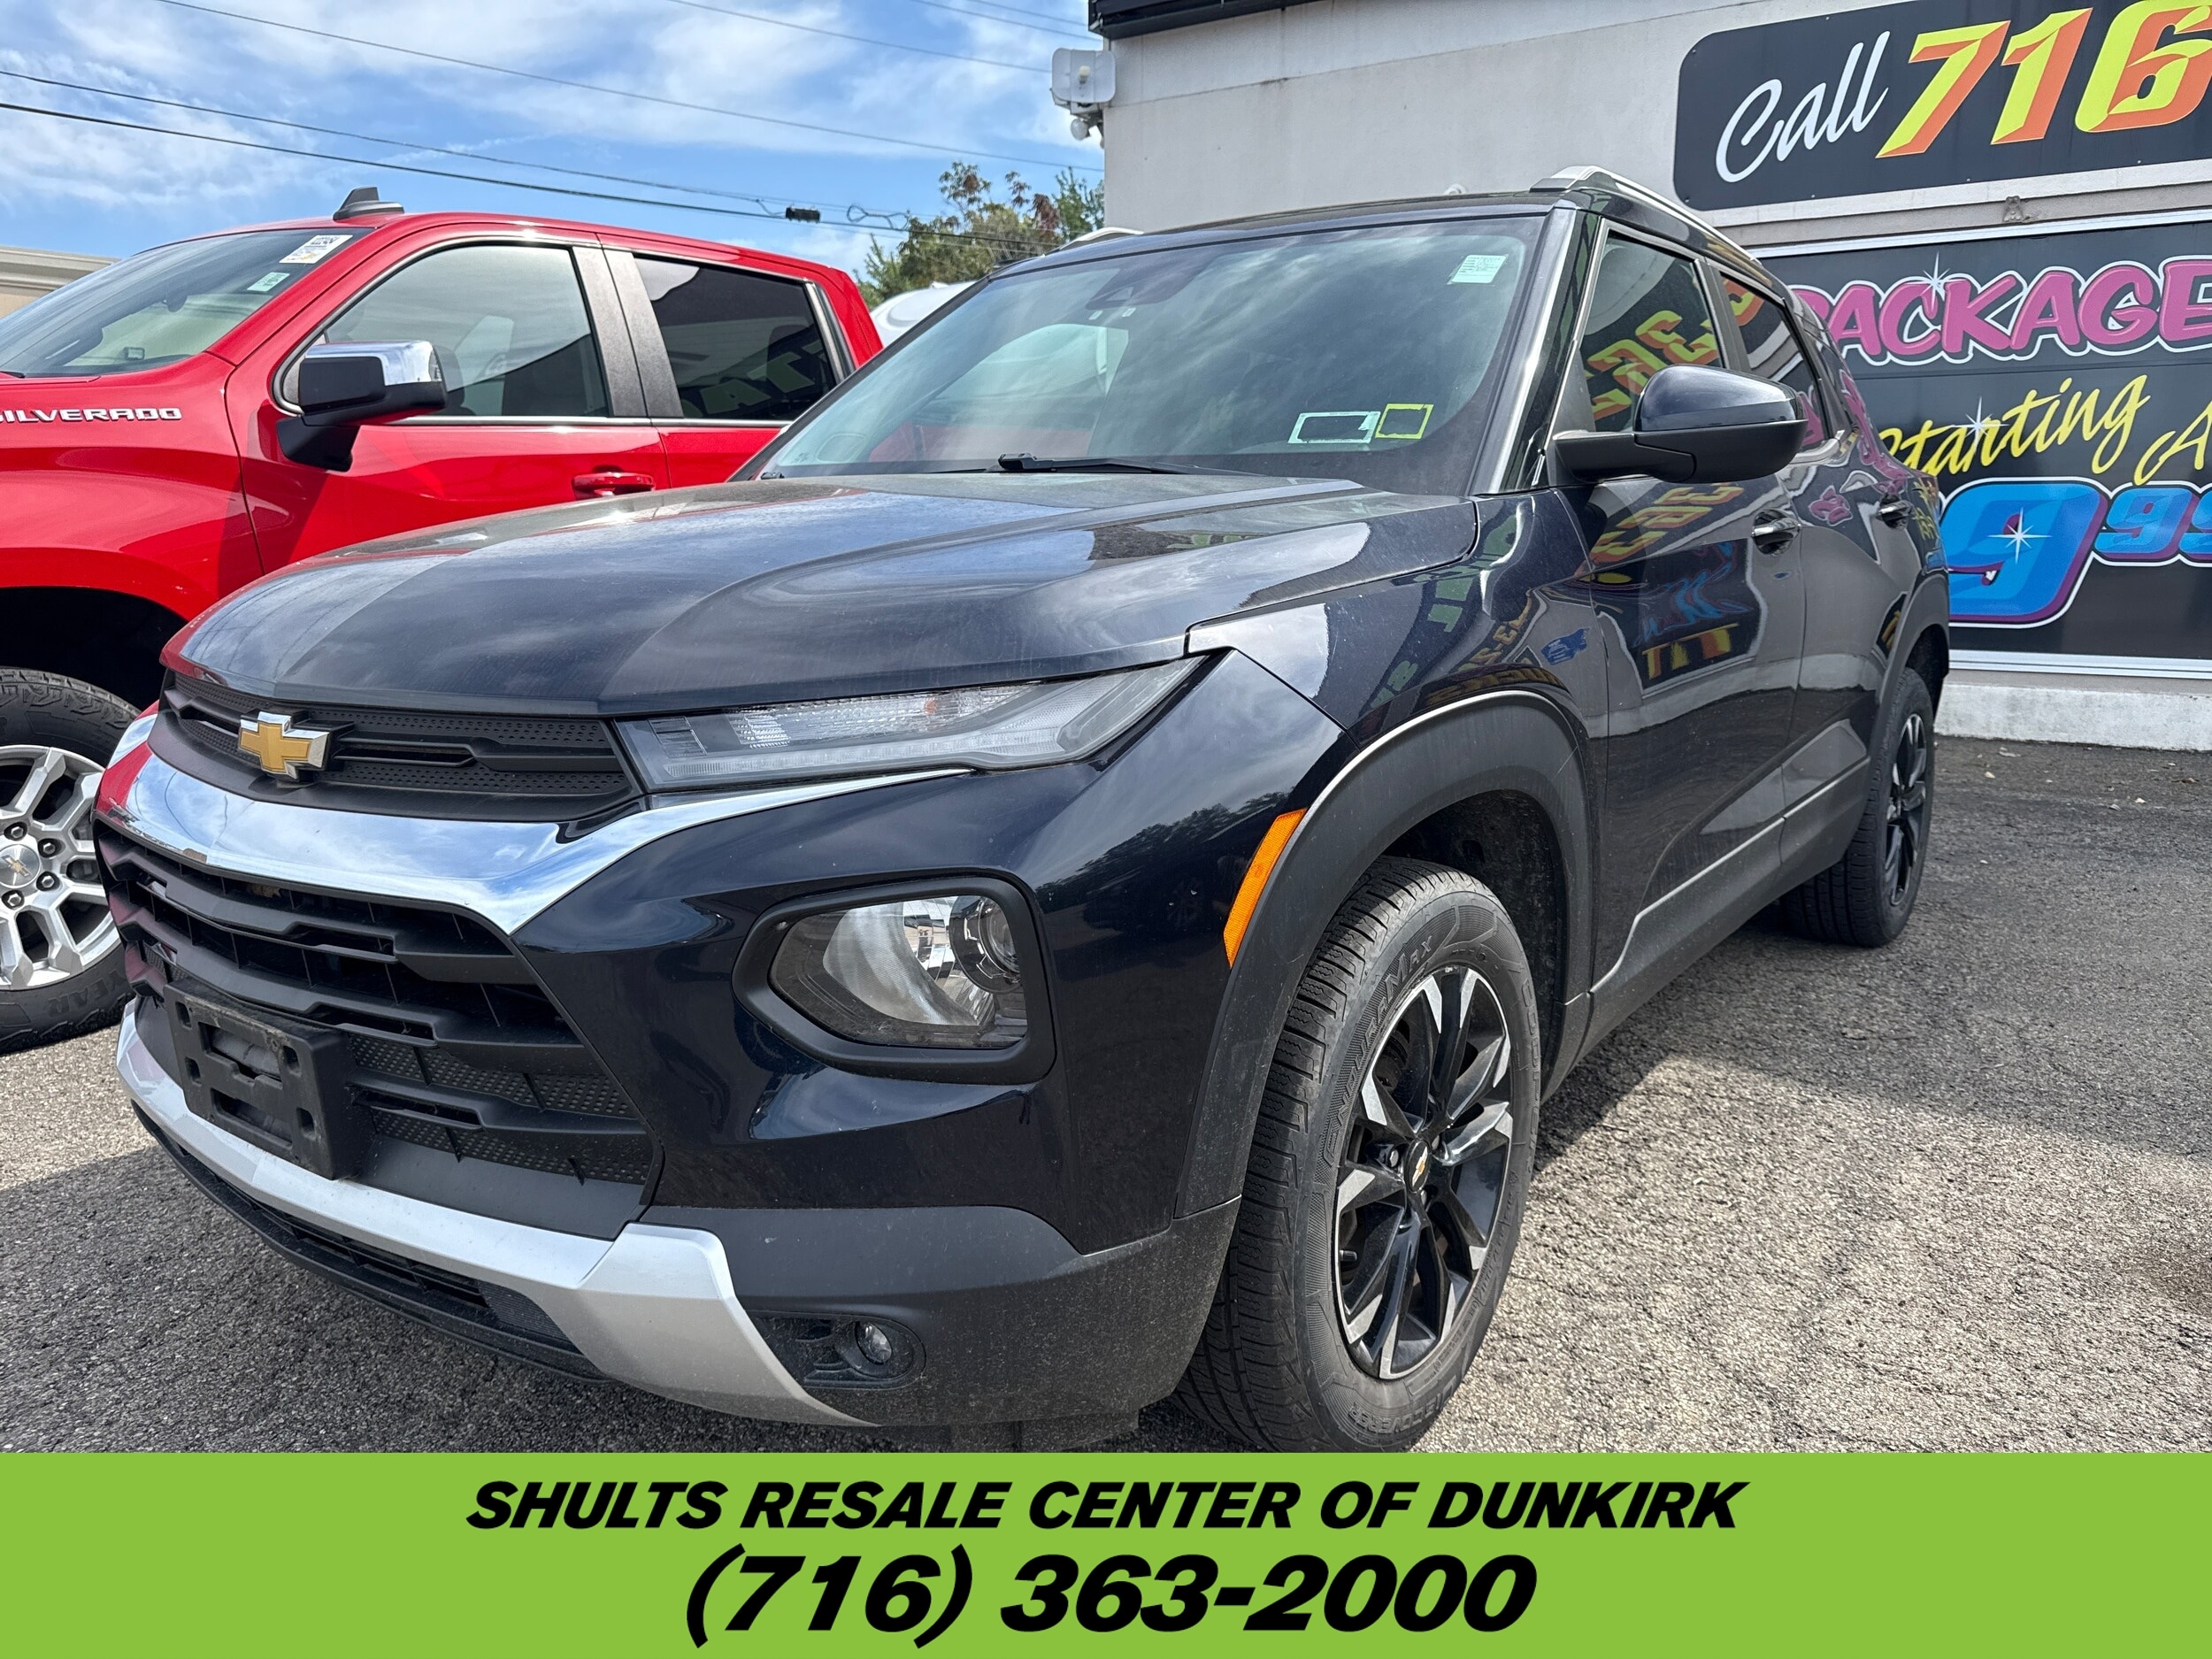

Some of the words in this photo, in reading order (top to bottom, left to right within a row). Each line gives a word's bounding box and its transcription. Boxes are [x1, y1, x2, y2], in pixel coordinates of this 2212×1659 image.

[1715, 31, 1890, 183] Call
[1875, 0, 2212, 159] 716
[1791, 257, 2212, 358] ACKAGE
[0, 408, 182, 423] ILVERADO
